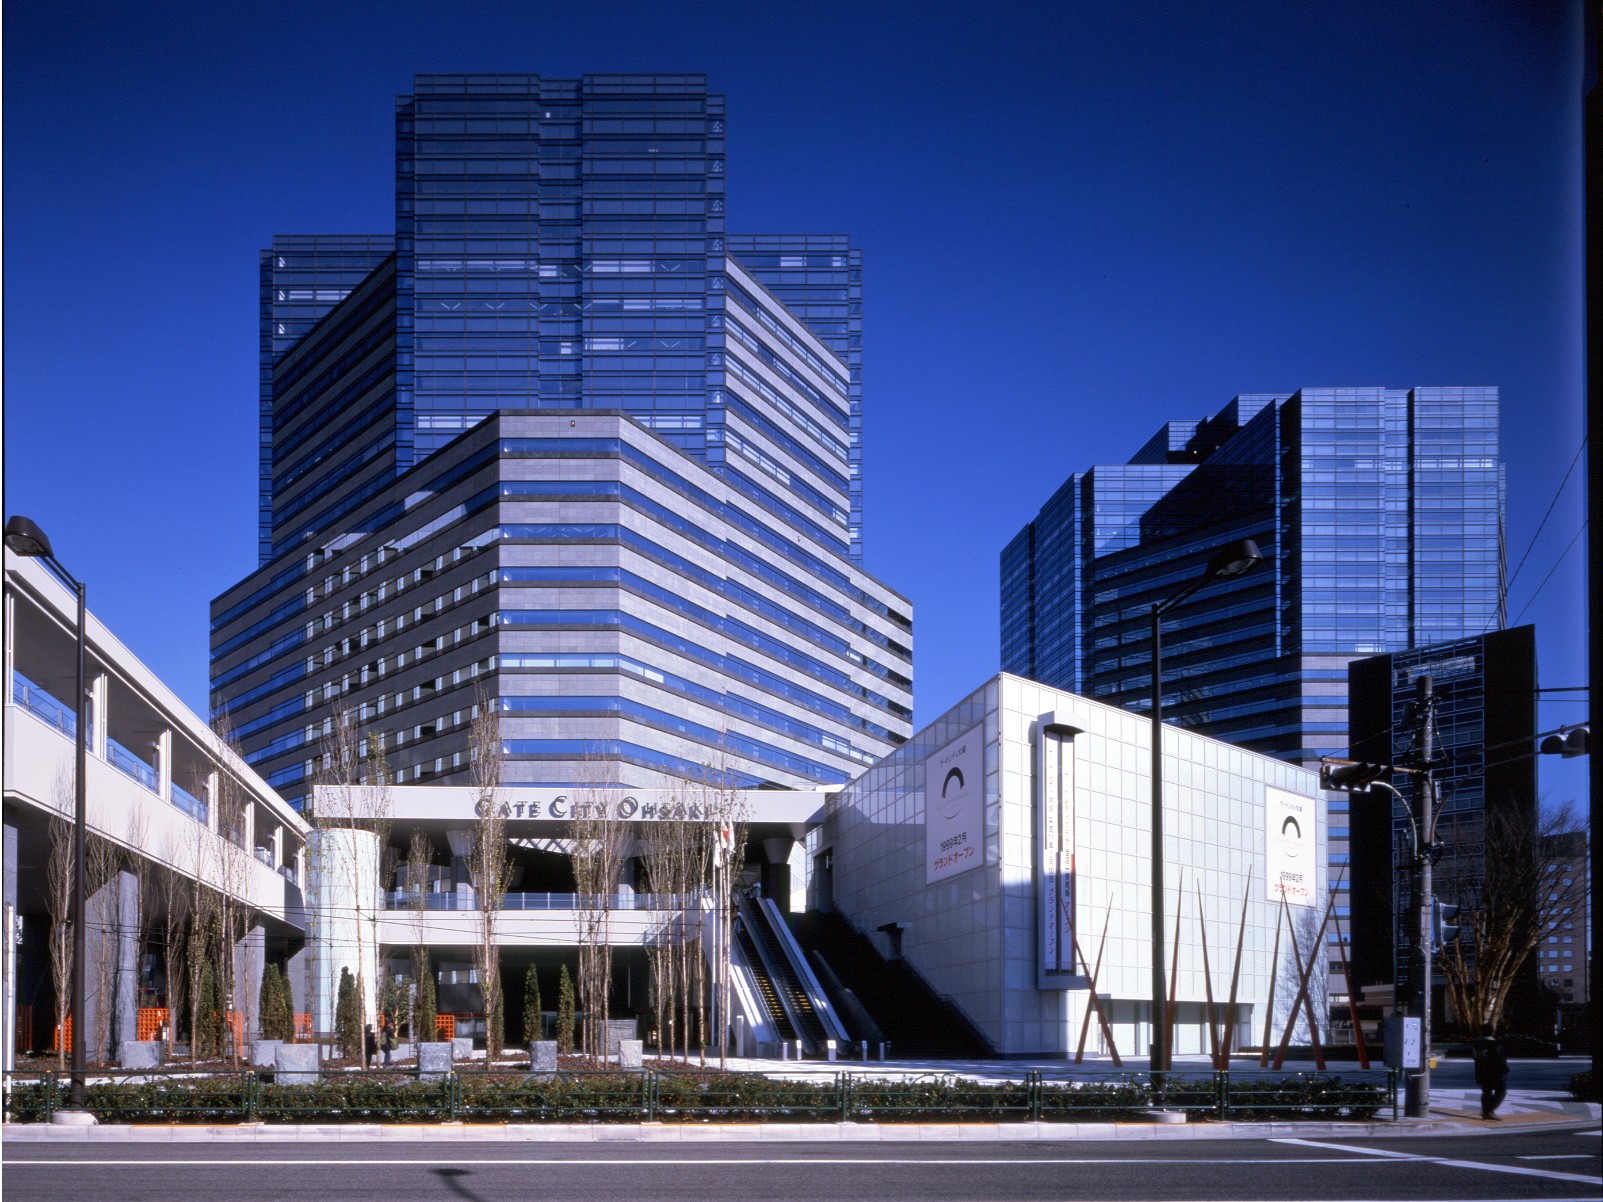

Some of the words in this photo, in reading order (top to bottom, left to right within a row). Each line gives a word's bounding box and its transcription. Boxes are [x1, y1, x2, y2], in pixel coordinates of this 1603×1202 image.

[475, 795, 541, 818] GATE
[549, 795, 607, 818] CITY
[940, 831, 967, 853] 1999年2月
[934, 847, 975, 871] グランドオープン
